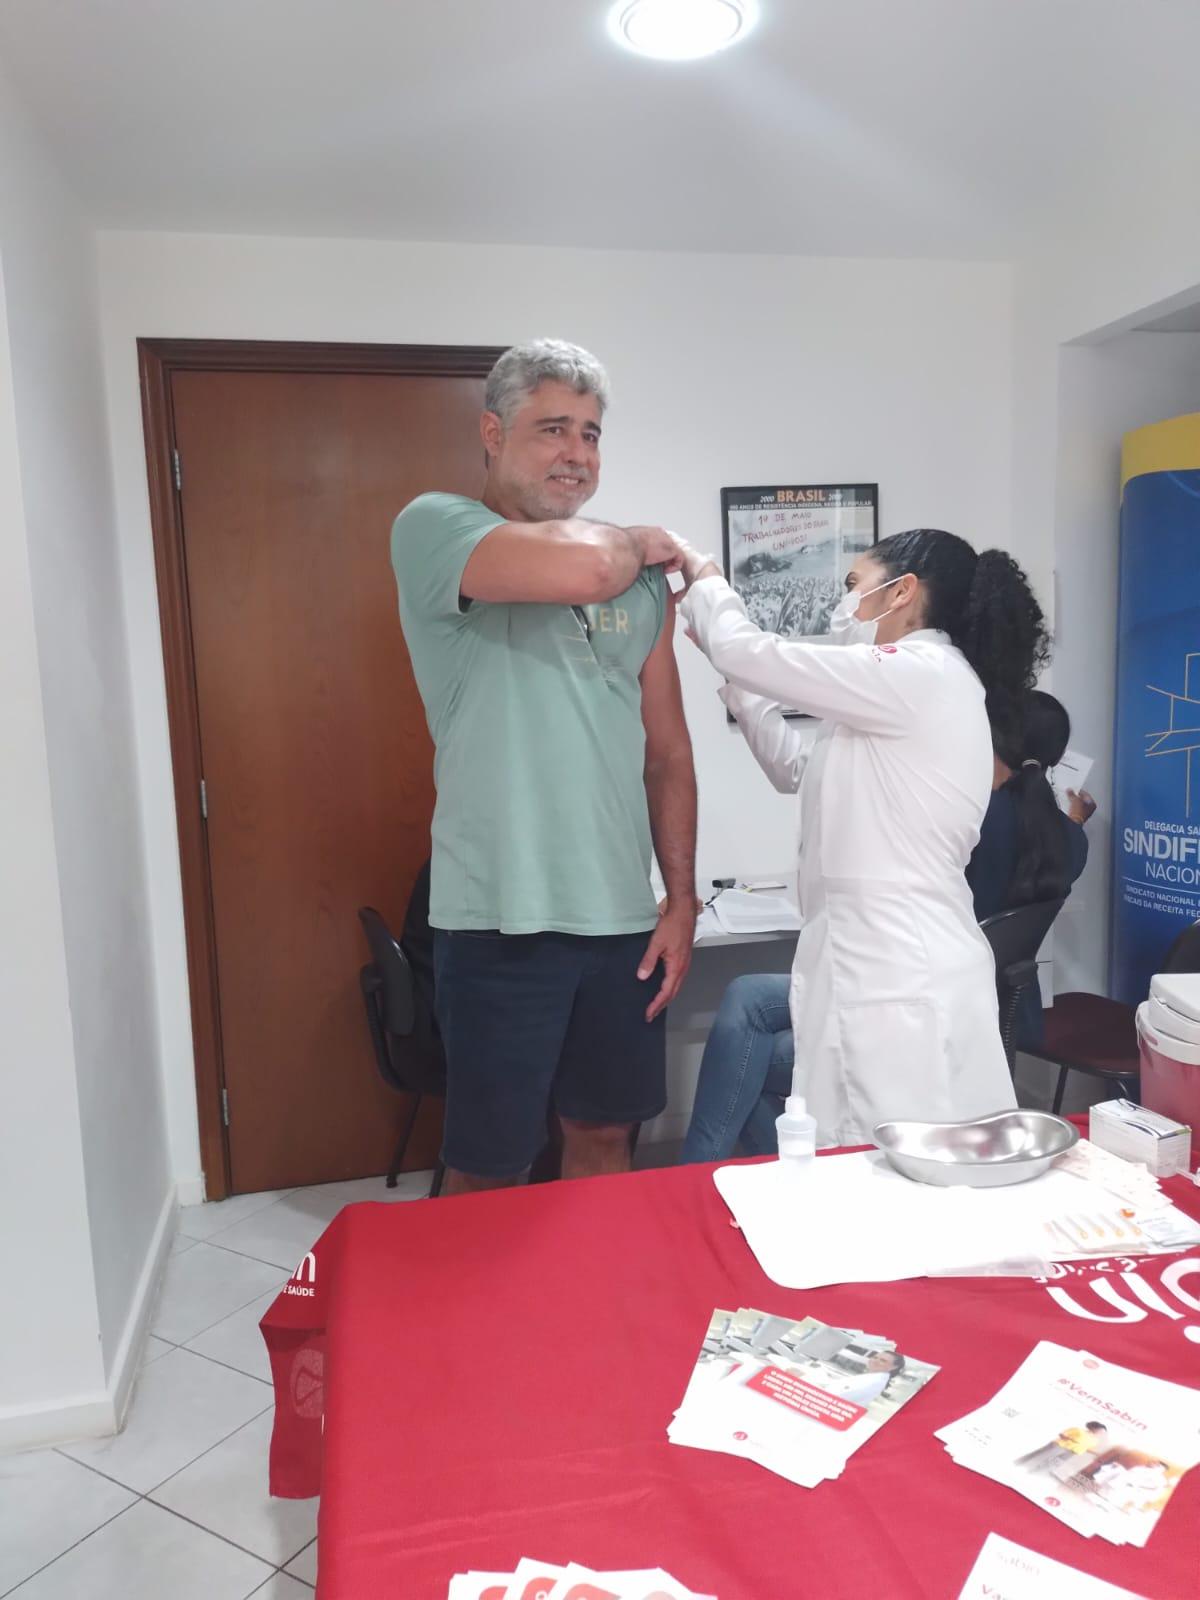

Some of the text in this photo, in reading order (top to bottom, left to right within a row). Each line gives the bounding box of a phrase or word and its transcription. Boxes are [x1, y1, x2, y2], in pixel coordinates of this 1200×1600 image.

[776, 489, 826, 503] BRASIL
[775, 513, 785, 522] DE
[792, 512, 812, 521] MAIO
[1144, 820, 1185, 834] DELEGACIA
[1156, 892, 1196, 906] NACIONAL
[1153, 902, 1184, 915] RECEITA
[288, 1285, 316, 1297] SAÚDE
